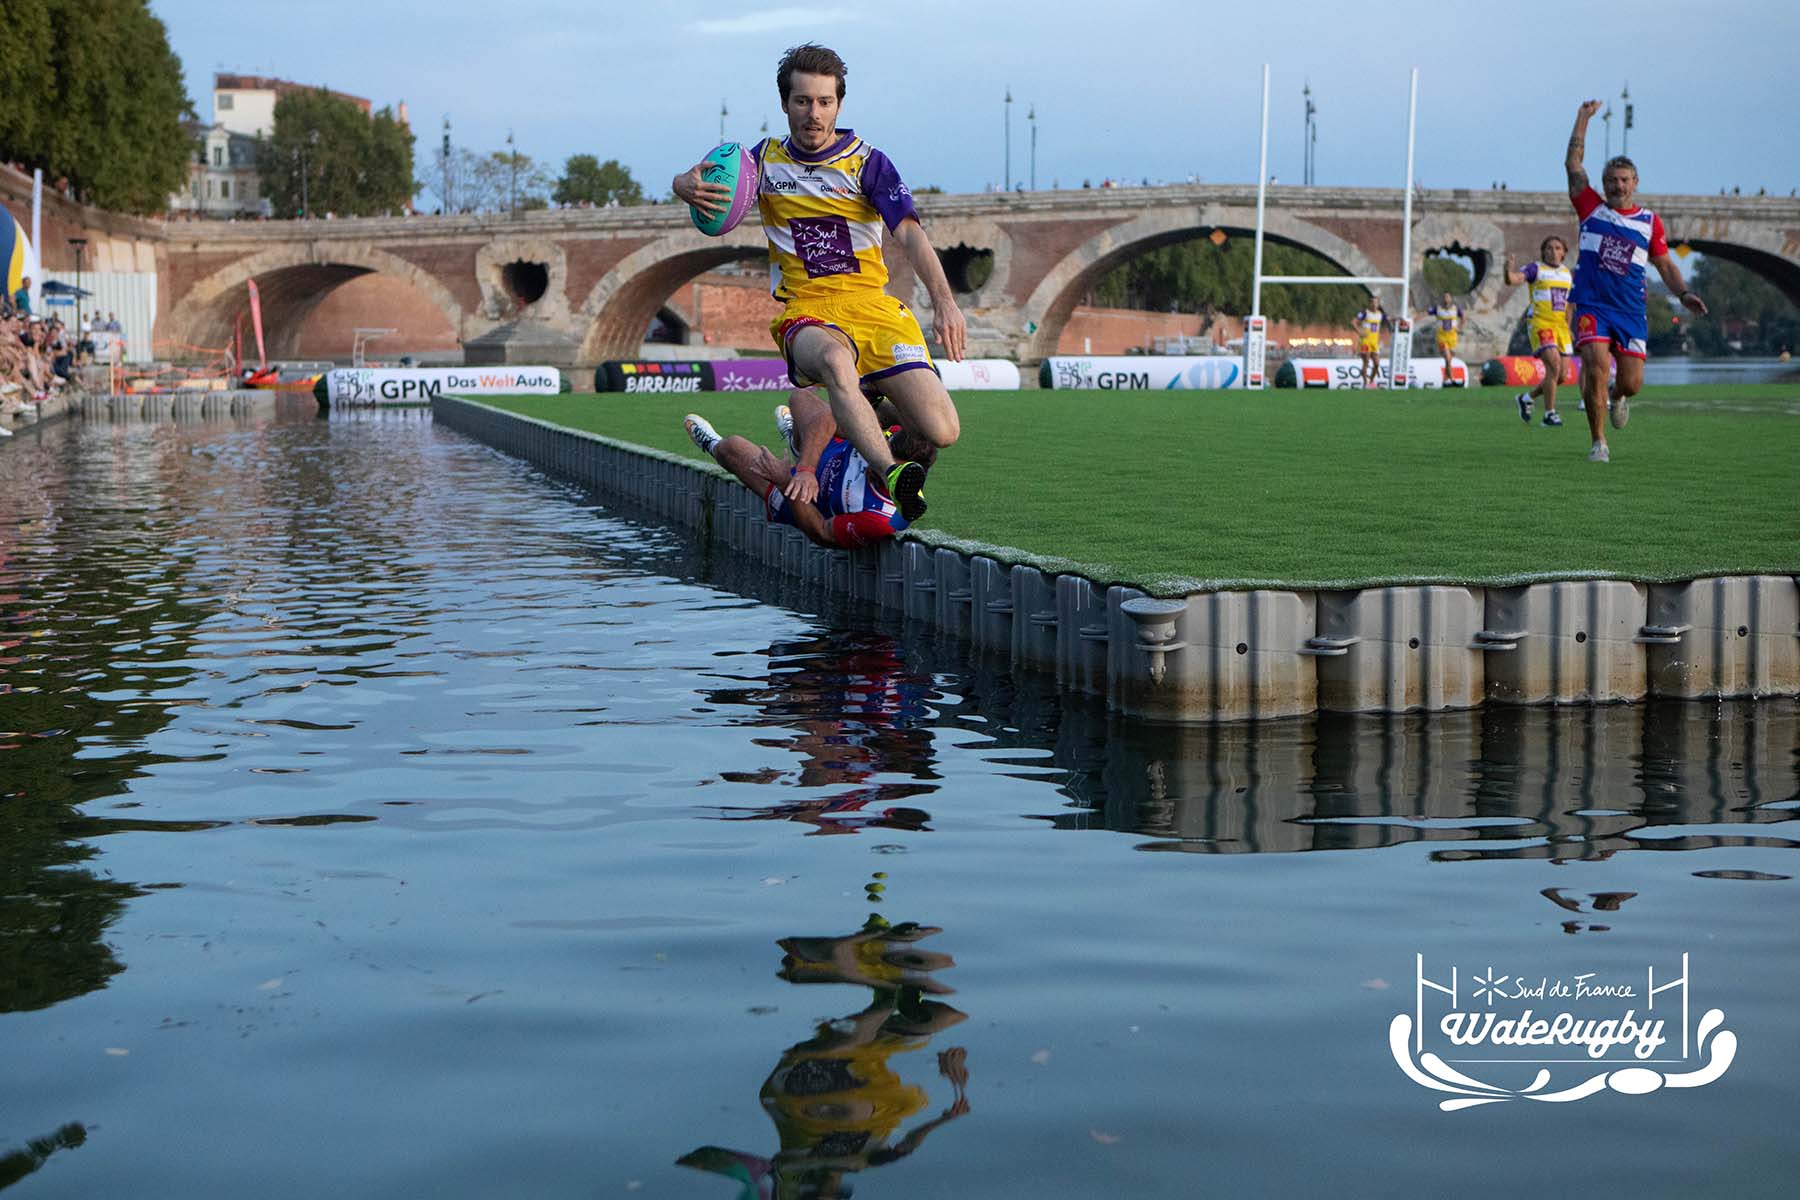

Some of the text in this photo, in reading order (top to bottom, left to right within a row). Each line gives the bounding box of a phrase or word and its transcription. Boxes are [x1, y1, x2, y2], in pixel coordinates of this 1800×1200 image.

[775, 181, 797, 190] GPM
[814, 223, 837, 240] Sud
[380, 379, 441, 400] GPM
[447, 375, 477, 389] Das
[625, 375, 702, 392] BARRAQUE
[744, 376, 765, 390] Sud
[1097, 372, 1149, 390] GPM
